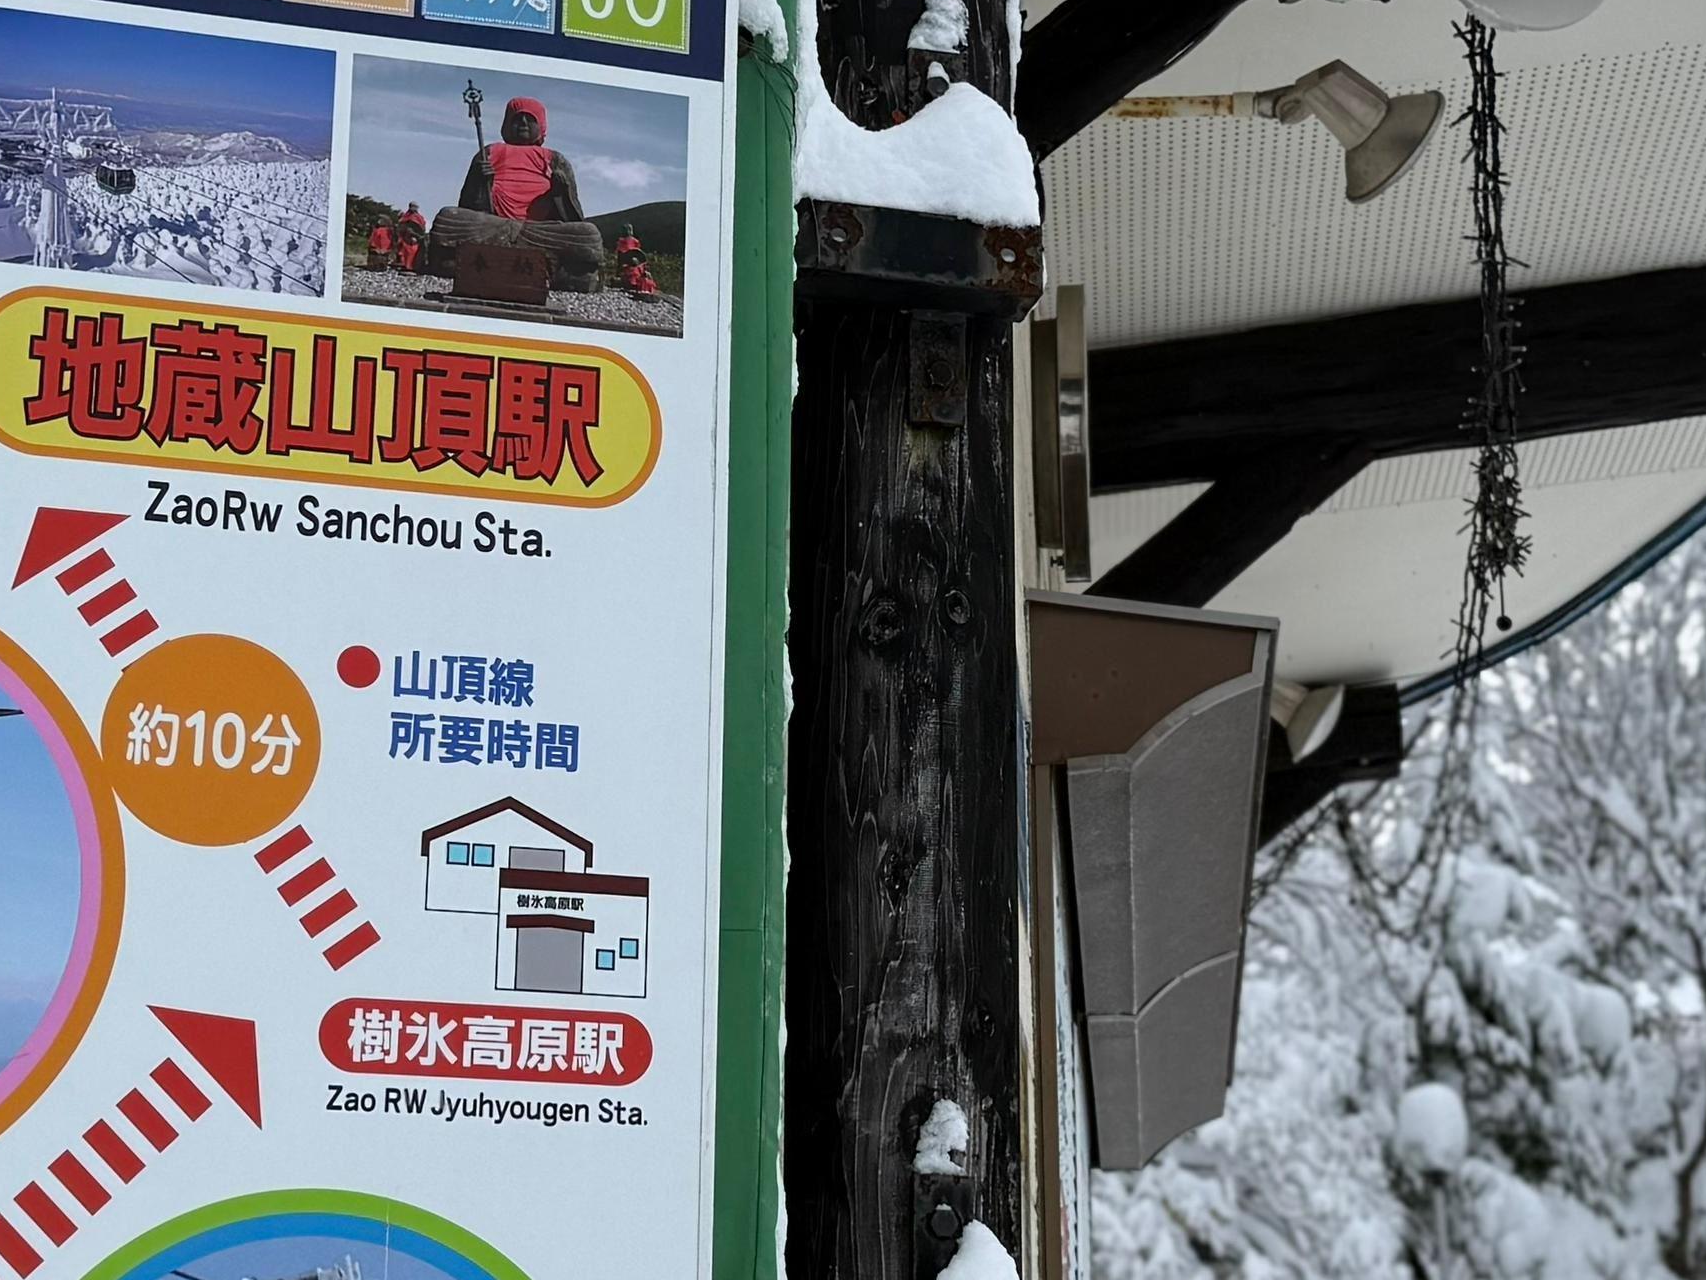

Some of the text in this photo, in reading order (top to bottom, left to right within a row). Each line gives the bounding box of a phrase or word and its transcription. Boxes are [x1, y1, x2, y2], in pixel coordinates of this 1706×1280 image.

[24, 307, 604, 488] 地蔵山頂駅
[296, 495, 463, 552] Sanchou
[473, 511, 553, 558] Sta.
[393, 650, 536, 709] 山頂線
[126, 701, 303, 777] 約10分
[388, 711, 581, 773] 所要時間
[347, 1007, 625, 1076] 樹氷高原駅
[326, 1085, 648, 1127] Zao RW Jyuhyougen Sta.
